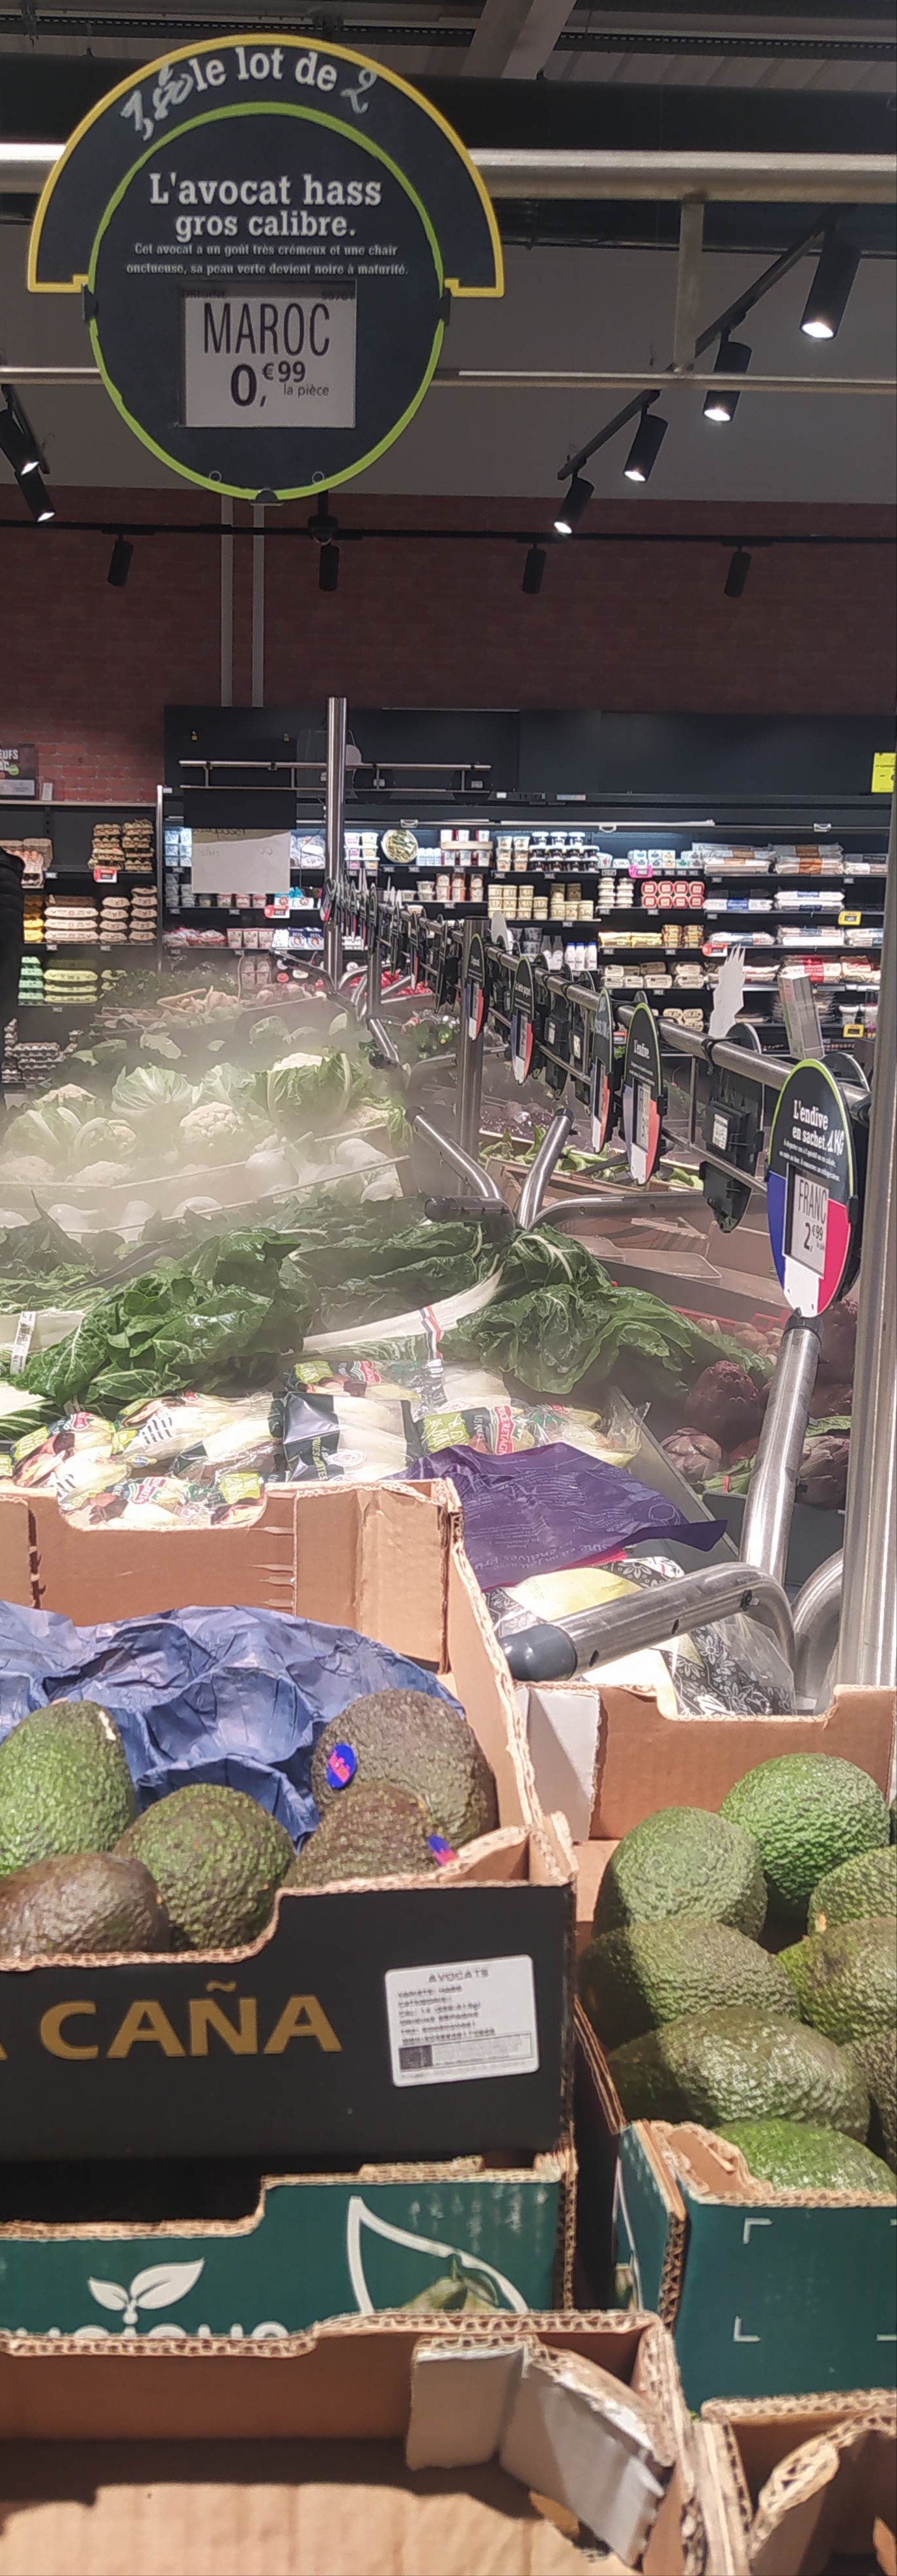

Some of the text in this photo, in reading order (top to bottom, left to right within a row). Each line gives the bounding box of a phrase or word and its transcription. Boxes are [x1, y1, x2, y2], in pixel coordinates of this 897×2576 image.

[189, 46, 338, 92] le lot de
[340, 67, 378, 114] 2
[149, 171, 382, 206] L'avocat hass
[175, 210, 356, 243] gros calibre.
[135, 243, 398, 259] Cet avocat a un goût très crémeux et une chair
[126, 262, 409, 277] onctueuse, sa peau verte devient noire à maturité.
[203, 302, 331, 356] MAROC
[283, 384, 330, 399] la pièce
[793, 1099, 829, 1130] L'endive
[792, 1126, 802, 1140] en
[39, 1980, 342, 2061] CAÑA
